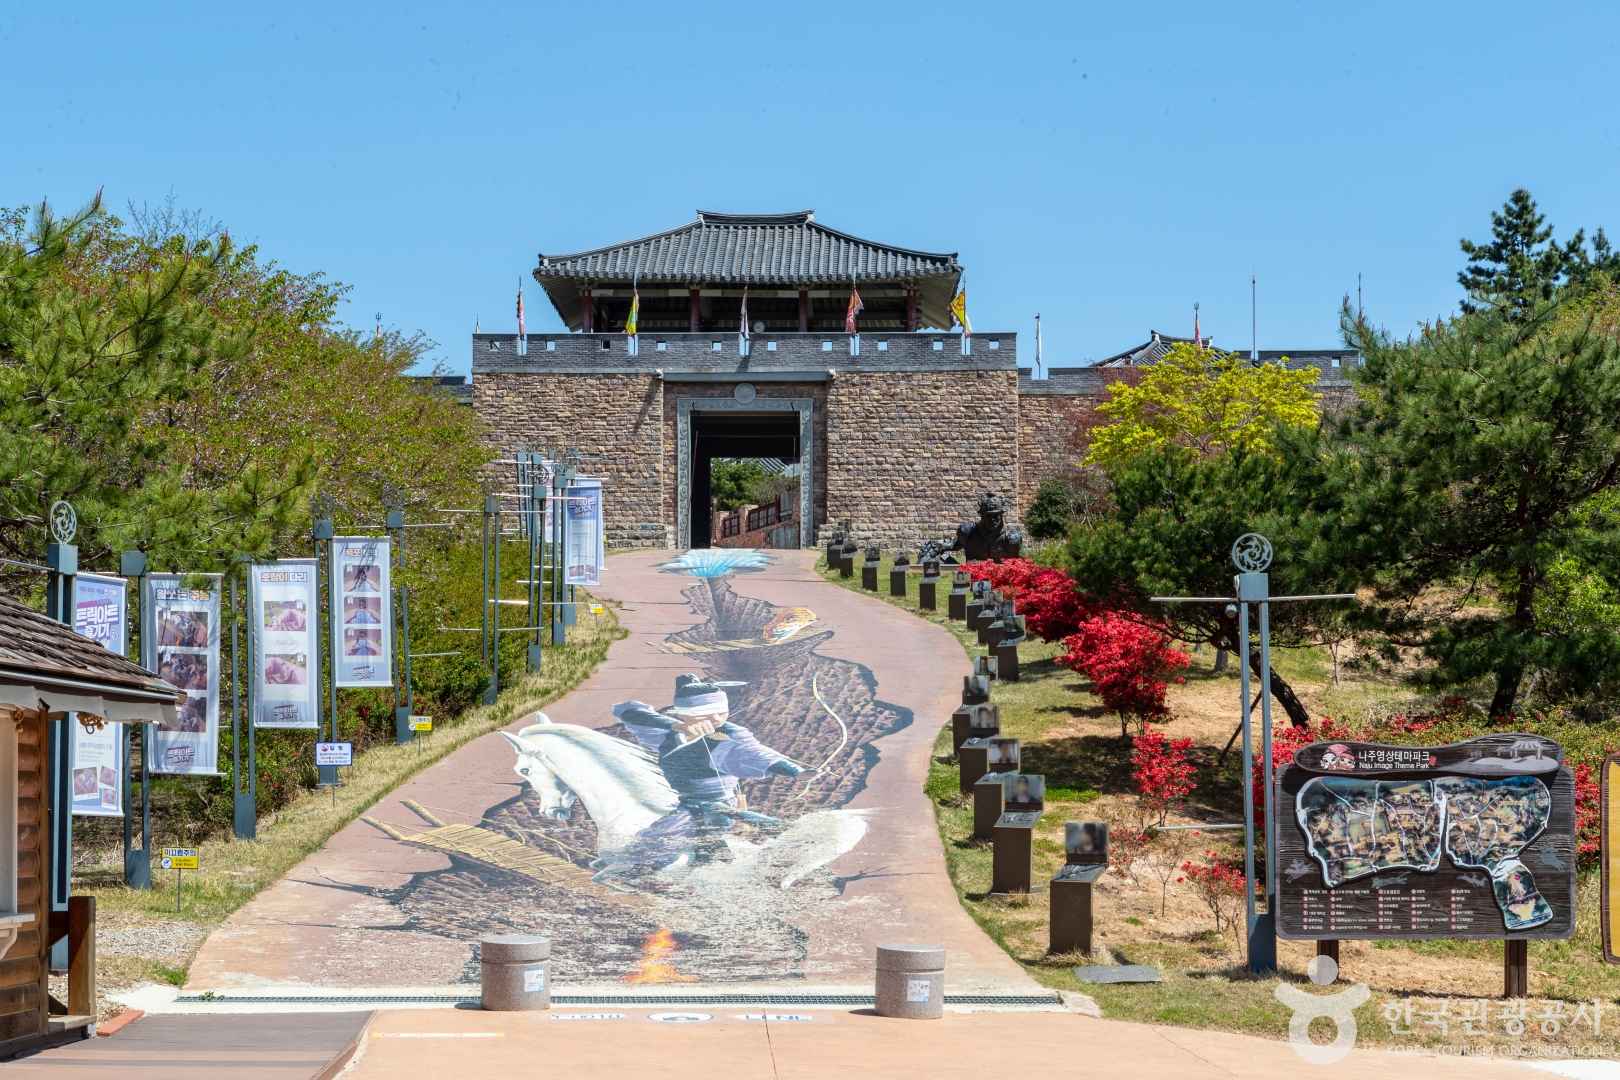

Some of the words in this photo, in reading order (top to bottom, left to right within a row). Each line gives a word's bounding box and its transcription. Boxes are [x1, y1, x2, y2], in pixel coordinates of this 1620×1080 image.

[76, 604, 118, 626] 트릭아트
[1359, 750, 1430, 762] 나주영상테마파크
[1374, 762, 1393, 770] Image
